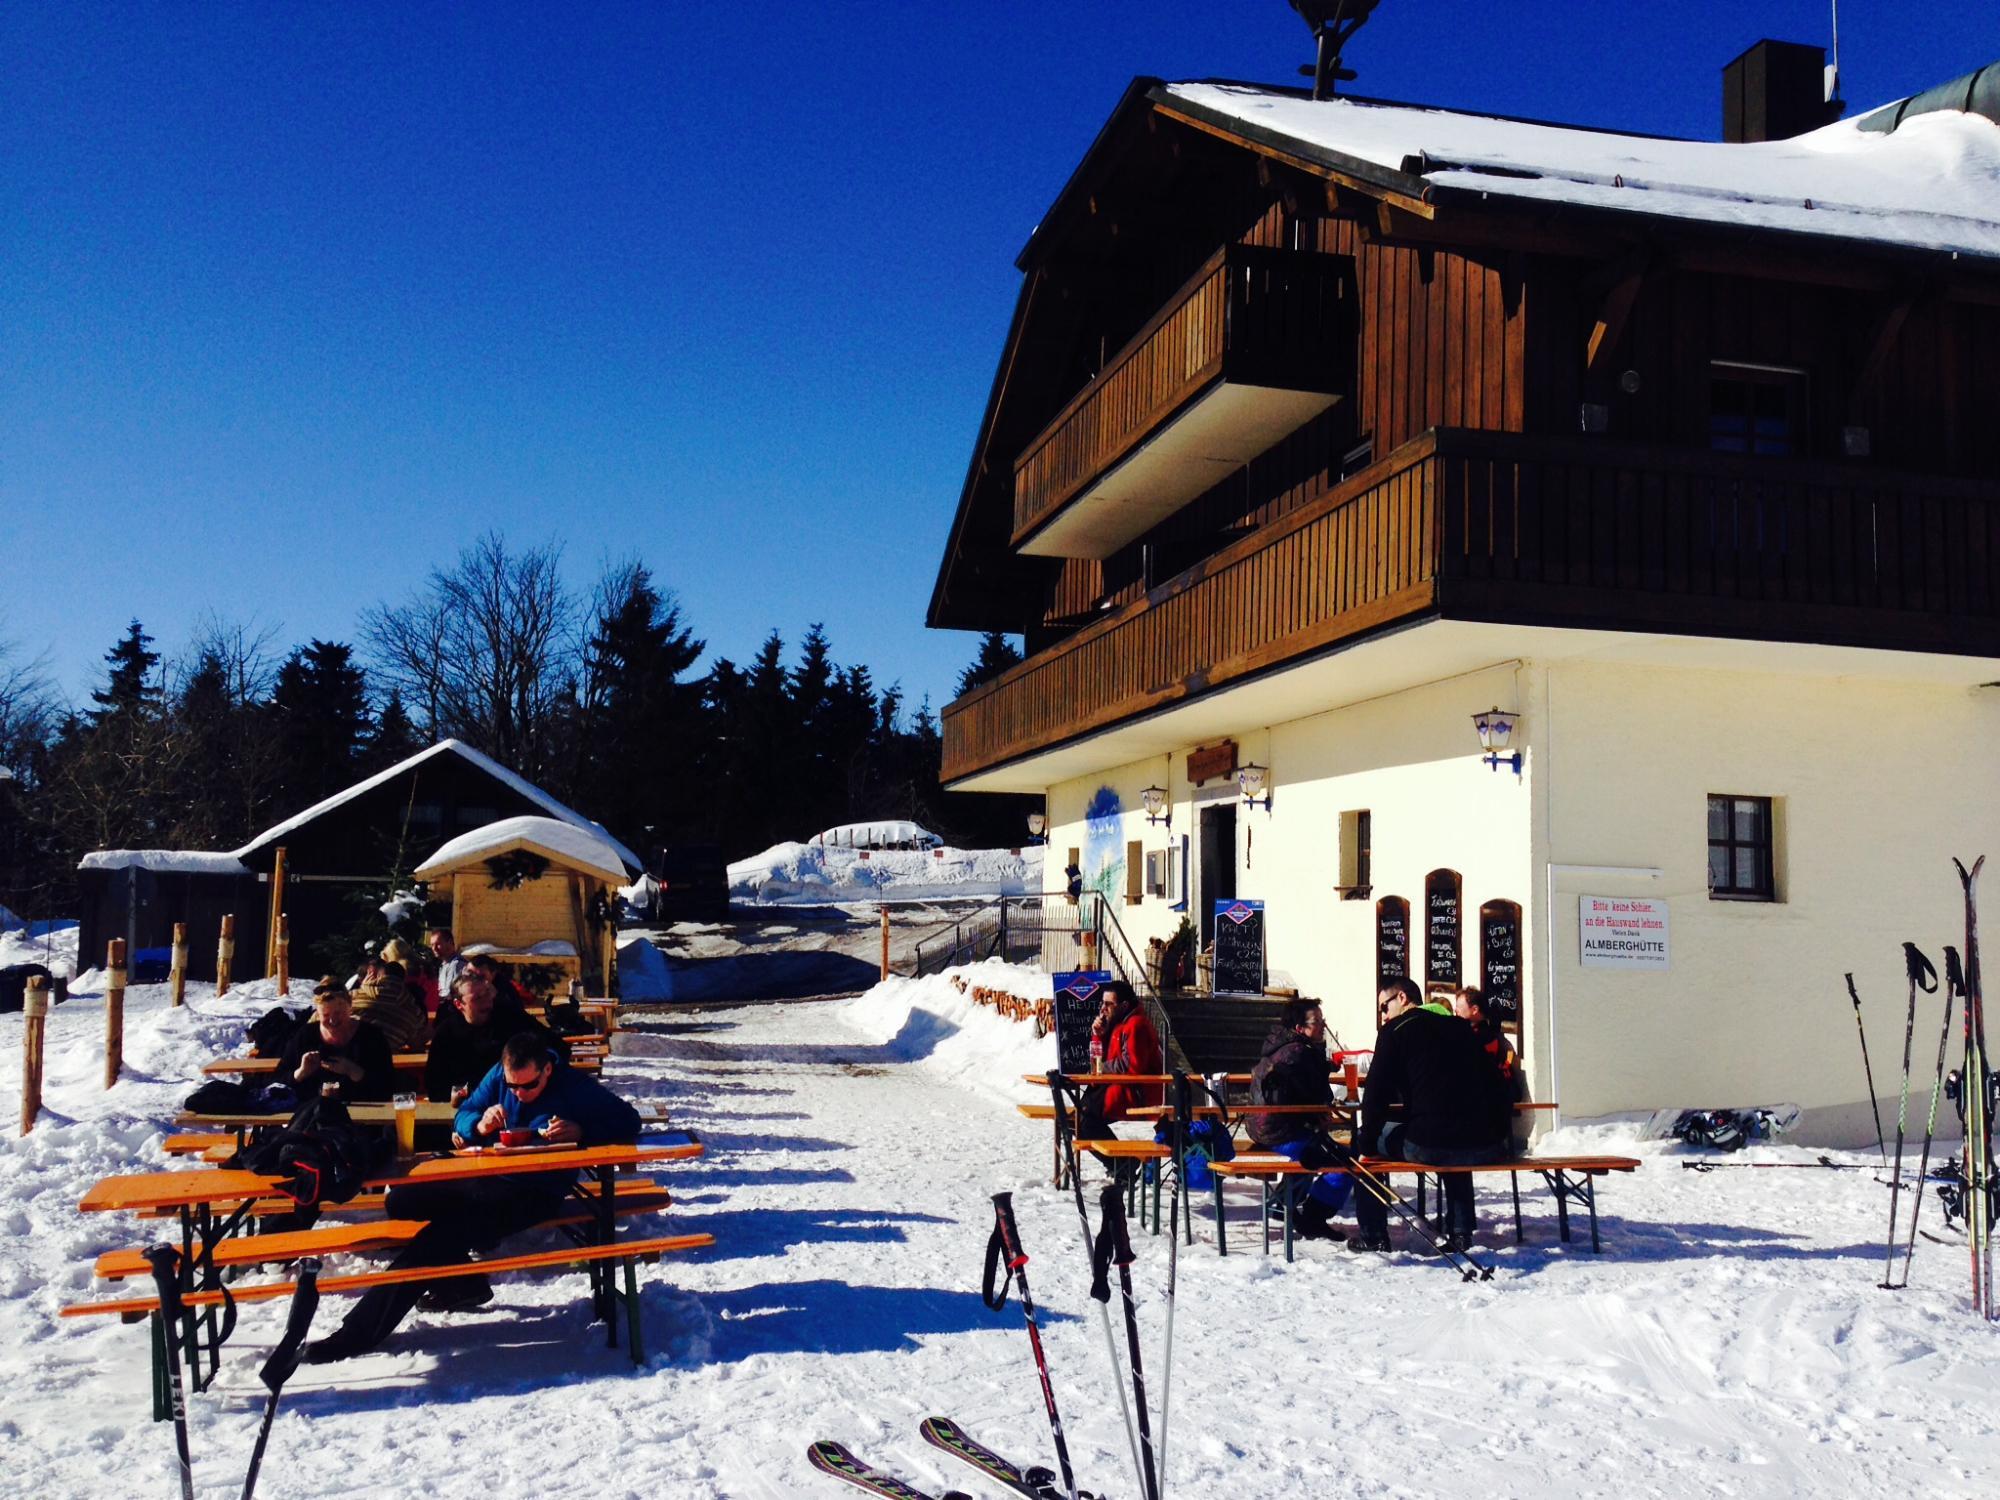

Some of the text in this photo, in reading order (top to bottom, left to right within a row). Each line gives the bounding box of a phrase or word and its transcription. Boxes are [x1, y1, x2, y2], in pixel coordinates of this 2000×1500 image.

[1593, 900, 1608, 911] Bitte
[1612, 901, 1629, 912] keine
[1585, 918, 1593, 926] an
[1595, 916, 1605, 927] die
[1606, 917, 1639, 928] Hauswand
[1585, 940, 1664, 952] ALMBERGHÜTTE
[169, 1374, 185, 1420] LEKI
